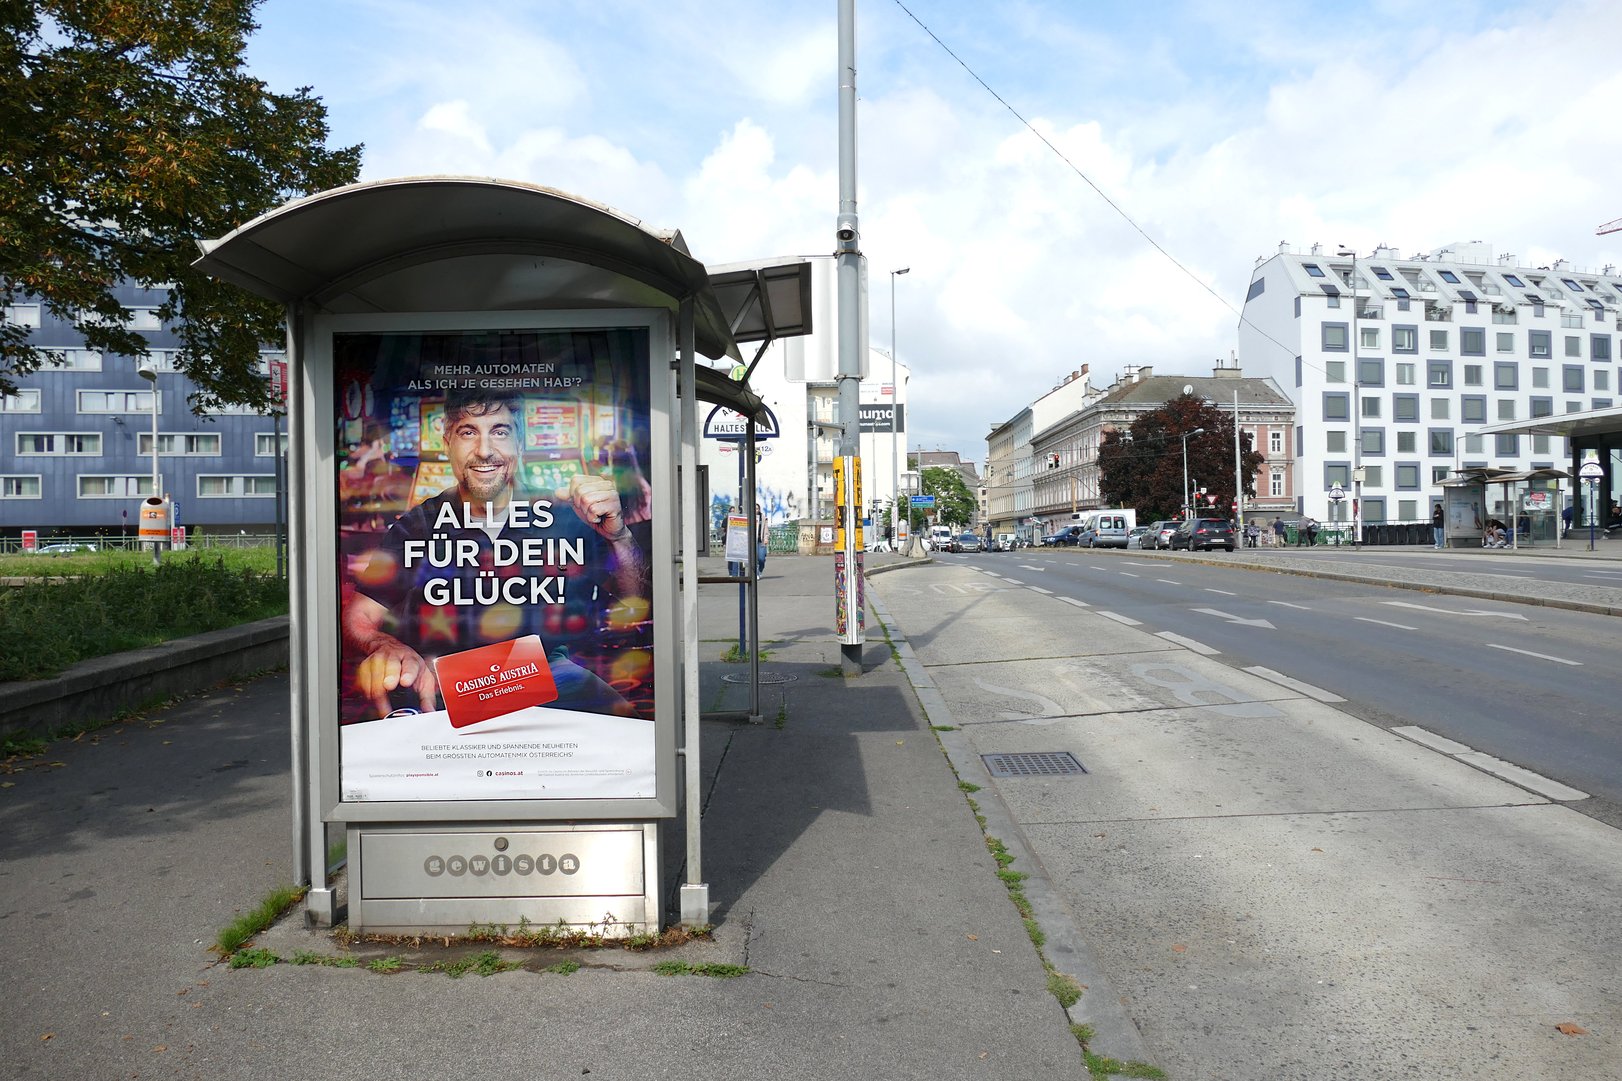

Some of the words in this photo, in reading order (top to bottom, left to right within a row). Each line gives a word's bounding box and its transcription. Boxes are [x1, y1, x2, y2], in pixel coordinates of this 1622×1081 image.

[434, 365, 471, 375] MEHR
[475, 363, 555, 375] AUTOMATEN
[407, 380, 432, 390] ALS
[435, 379, 457, 389] ICH
[460, 379, 476, 389] JE
[480, 377, 540, 388] GESEHEN
[432, 500, 554, 530] ALLES
[404, 533, 480, 568] FÜR
[493, 538, 585, 567] DEIN
[423, 571, 566, 606] GLÜCK!
[455, 674, 497, 693] CASINOS
[500, 662, 539, 682] AUSTRIA
[479, 691, 494, 701] Das
[494, 683, 525, 697] Erlebnis.
[425, 854, 579, 876] gewista
